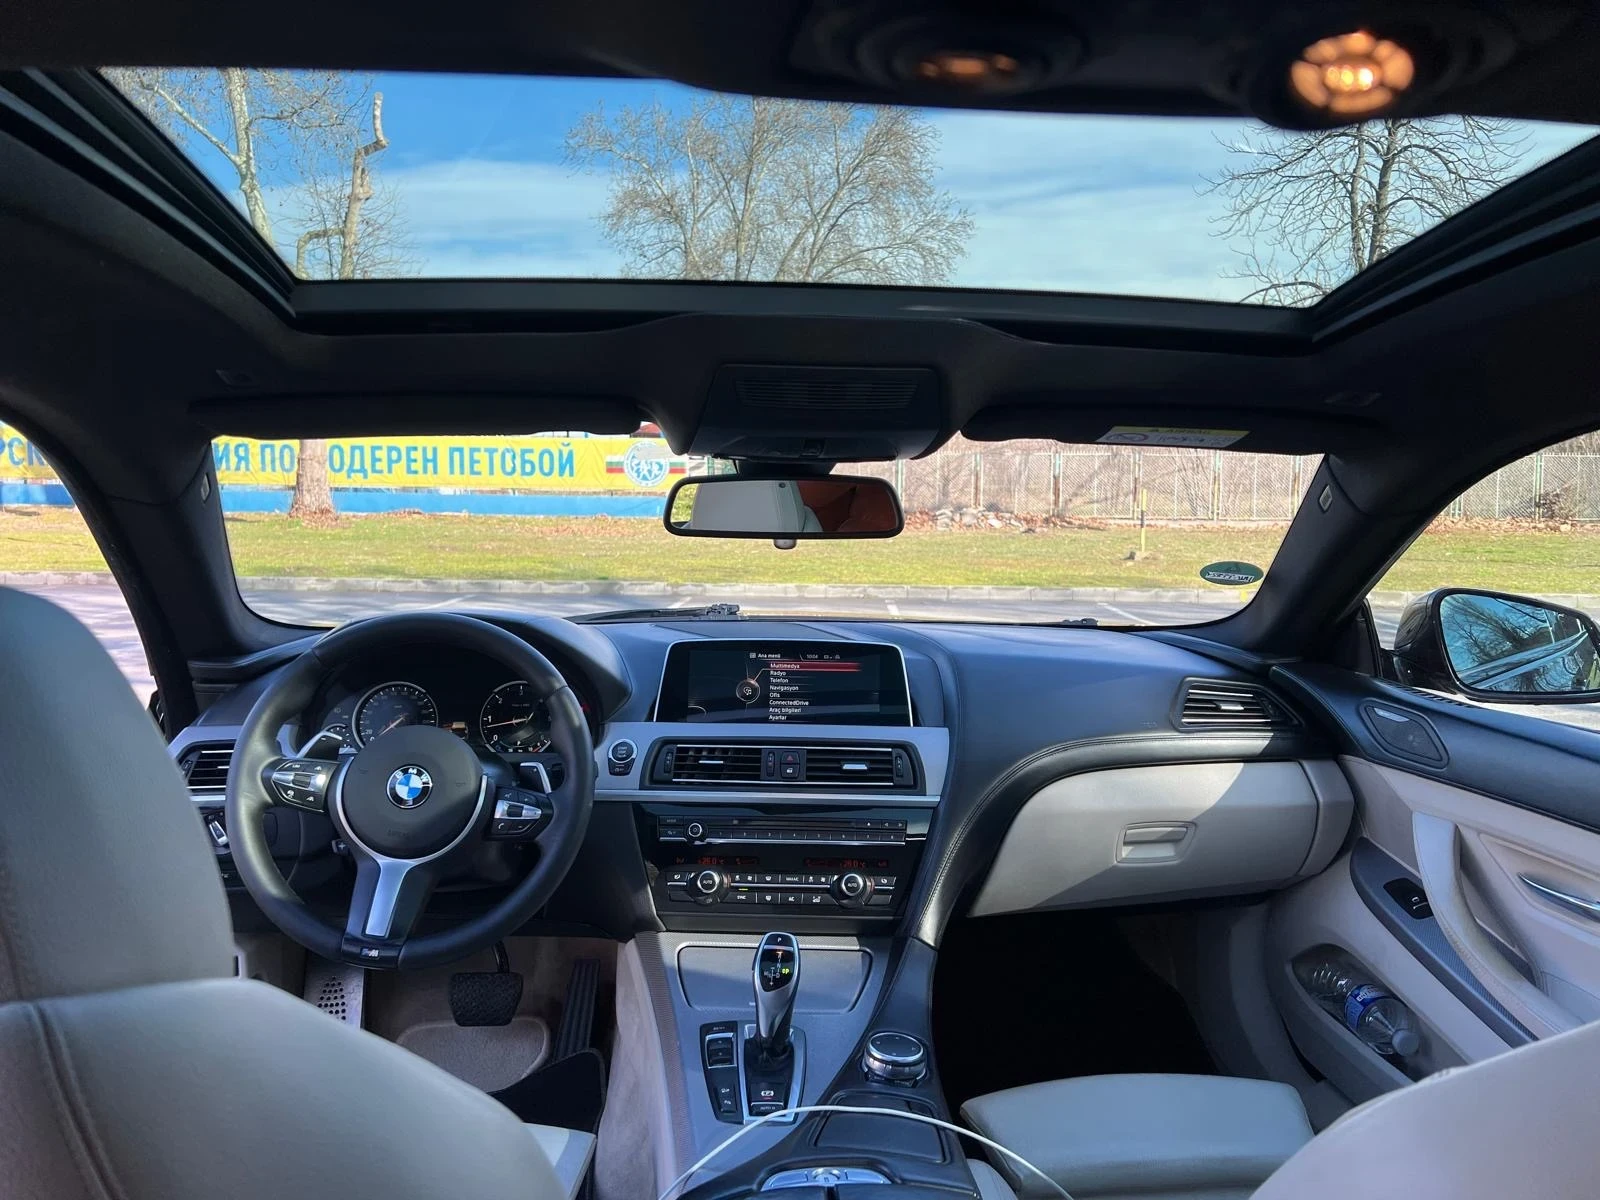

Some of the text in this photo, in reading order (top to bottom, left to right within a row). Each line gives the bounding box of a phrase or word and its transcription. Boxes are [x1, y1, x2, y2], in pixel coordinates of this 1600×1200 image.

[259, 443, 296, 473] ПО
[327, 444, 439, 480] ОДЕРЕН
[449, 442, 575, 478] ПЕТОБОЙ
